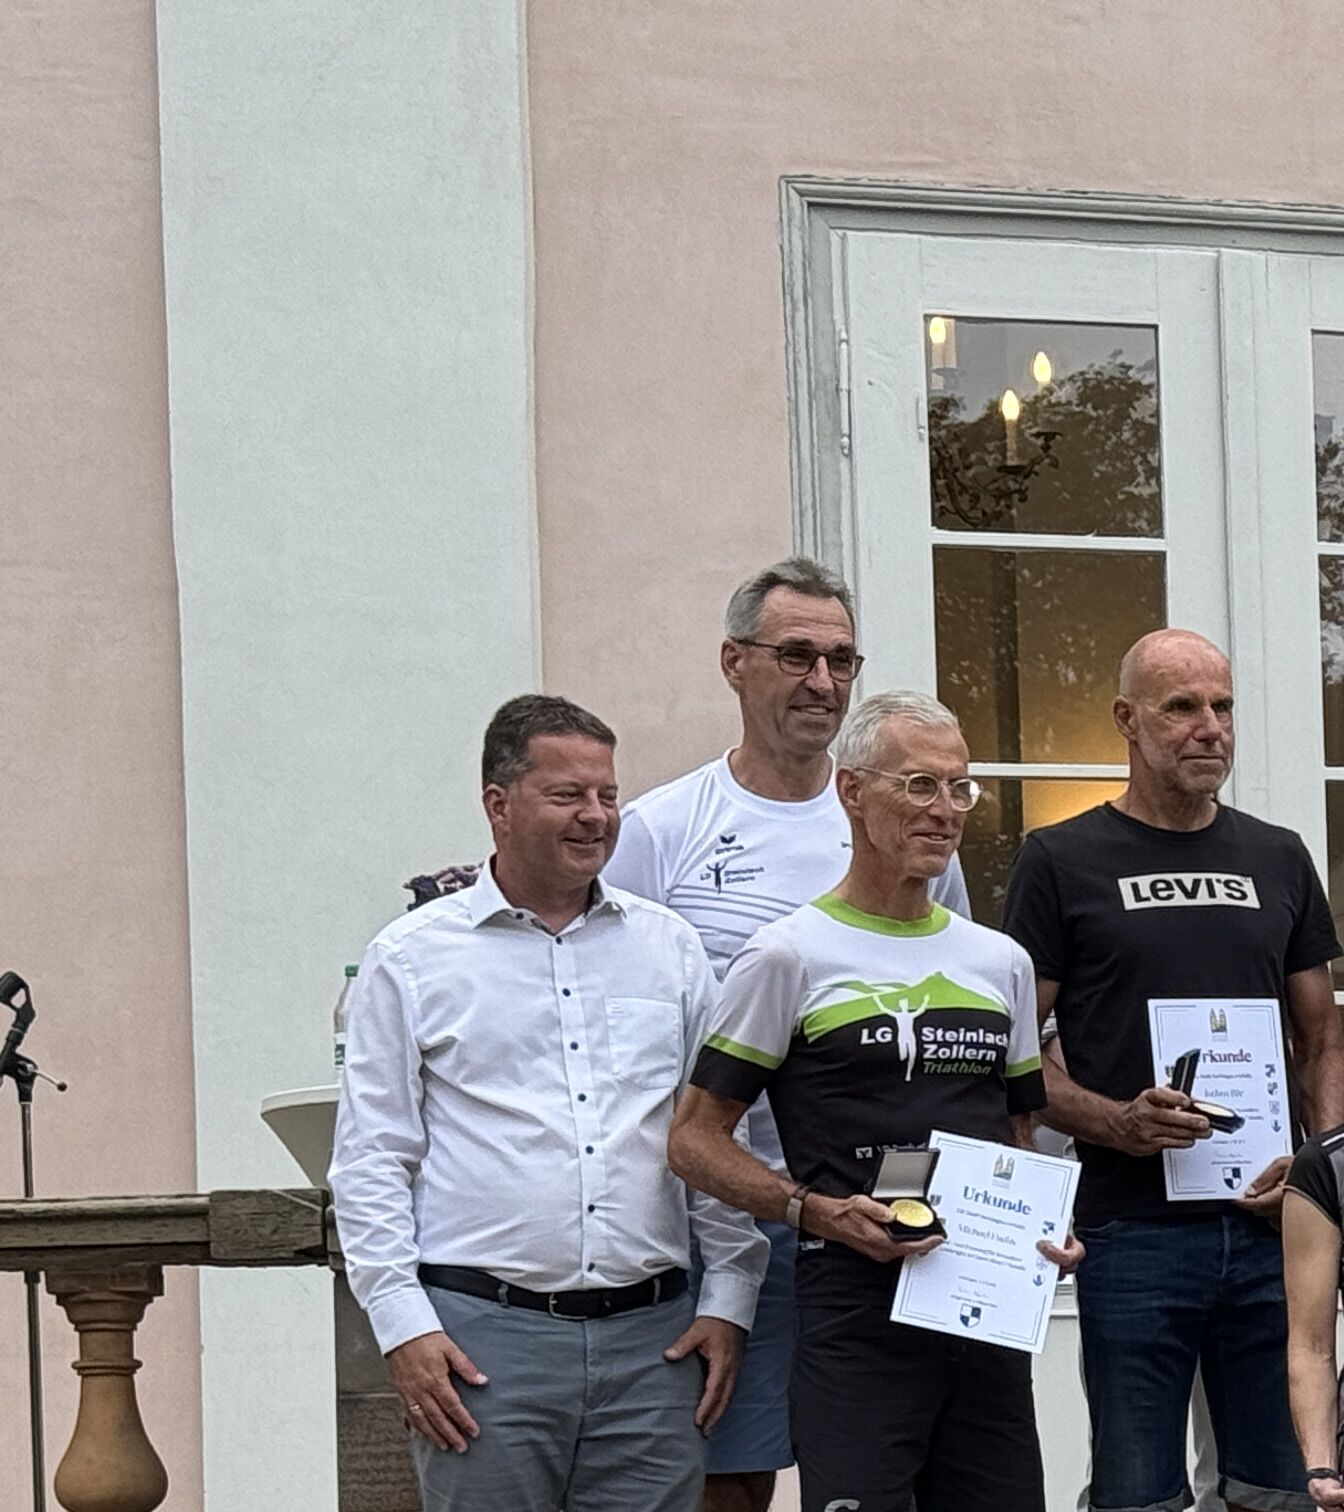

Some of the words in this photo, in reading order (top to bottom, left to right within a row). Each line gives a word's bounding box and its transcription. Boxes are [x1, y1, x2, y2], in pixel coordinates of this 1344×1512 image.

[860, 1027, 893, 1045] LG
[923, 1044, 997, 1062] Zollern
[1202, 1048, 1253, 1064] rkunde
[923, 1061, 993, 1075] Triathlon
[963, 1185, 1032, 1216] Urkunde
